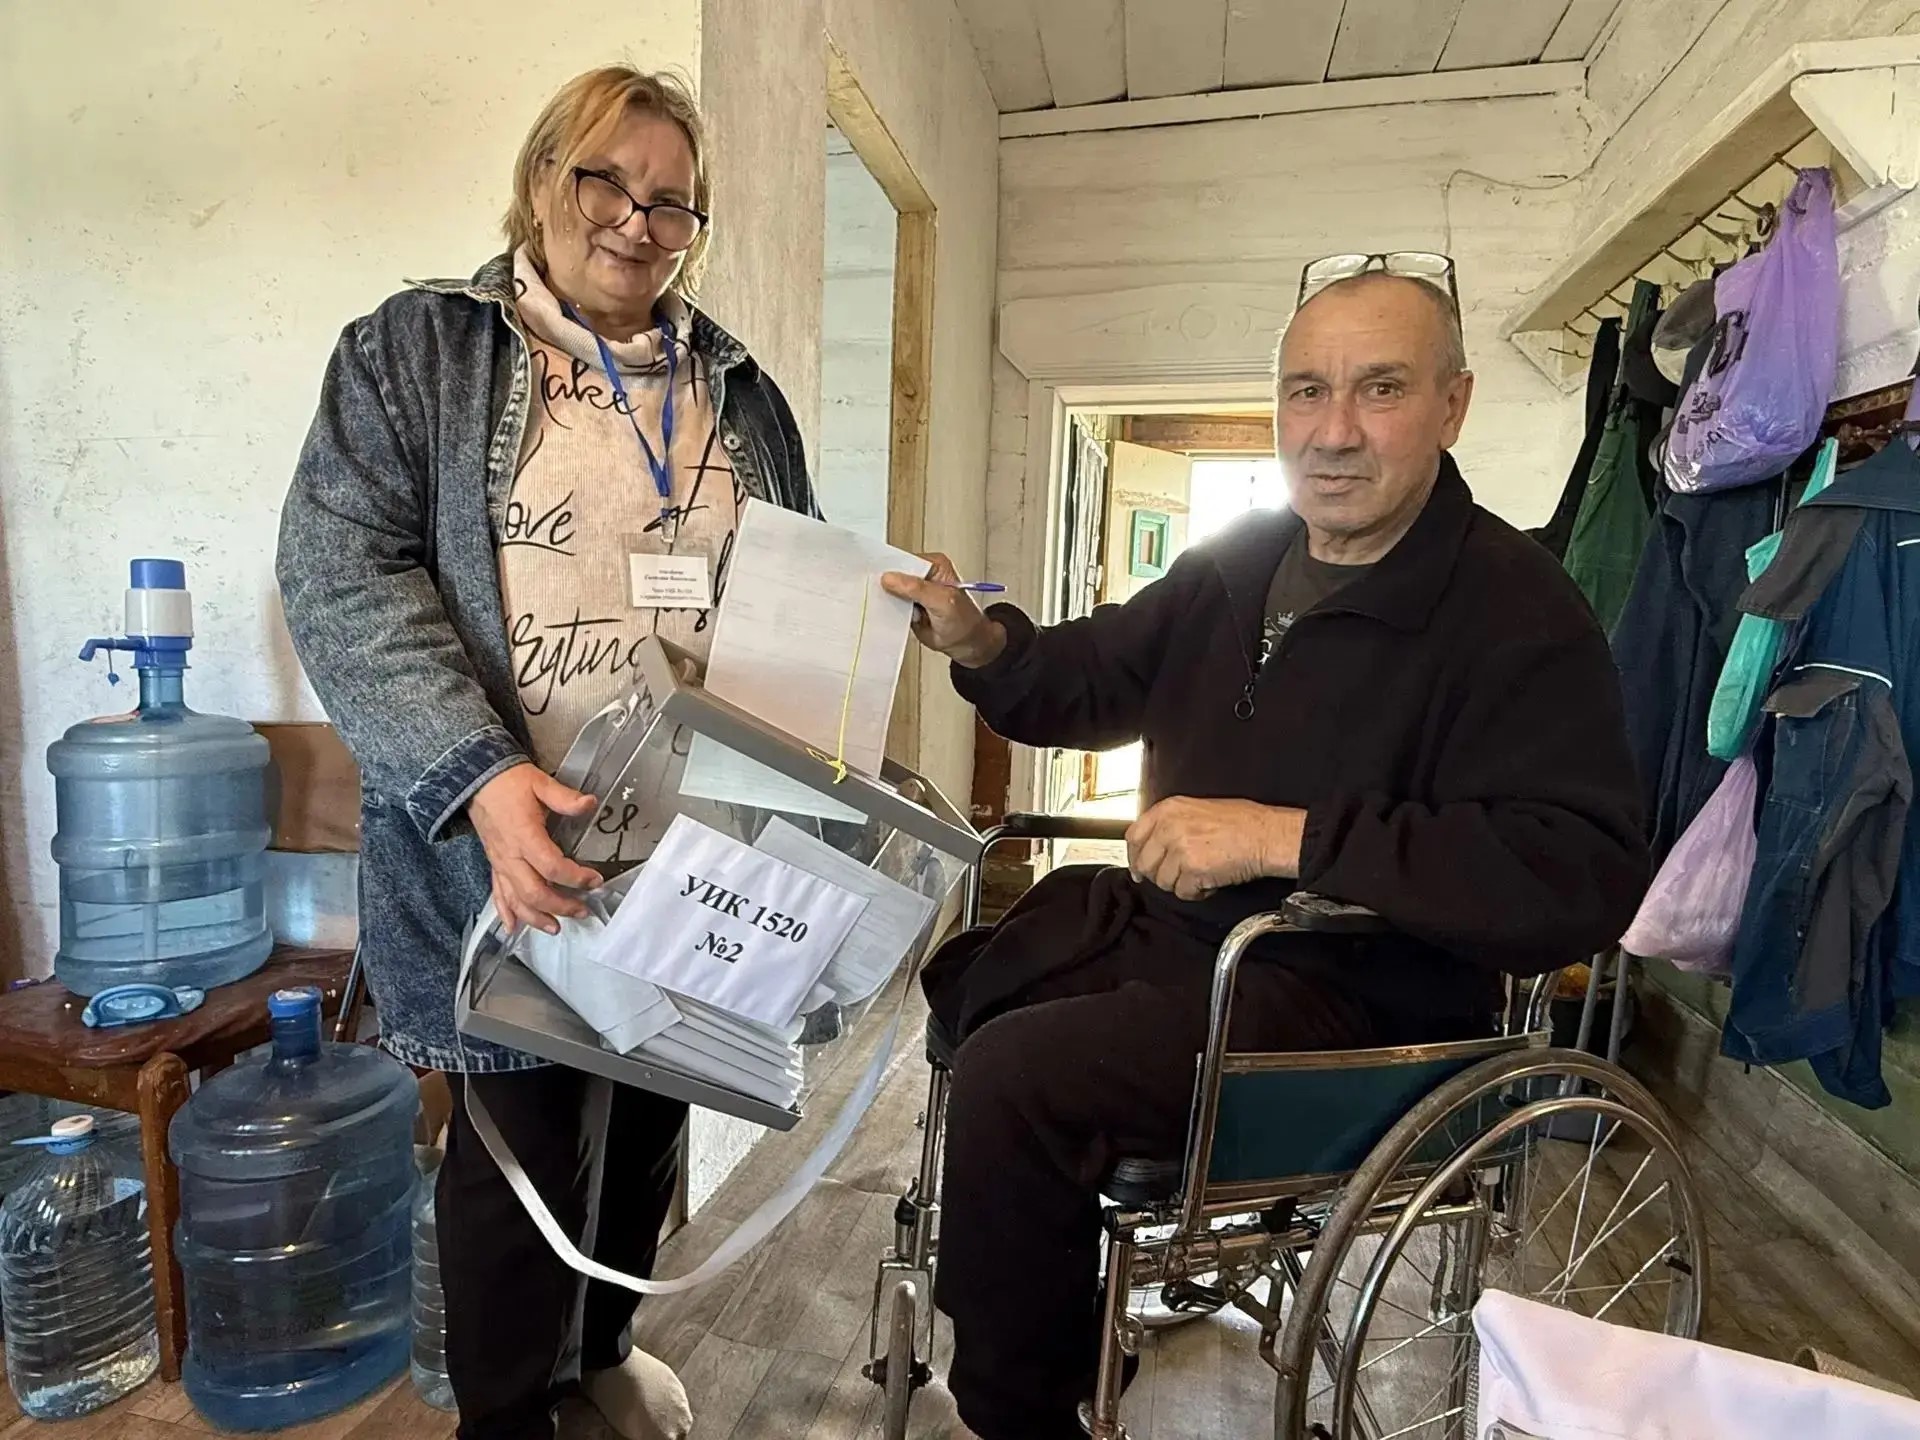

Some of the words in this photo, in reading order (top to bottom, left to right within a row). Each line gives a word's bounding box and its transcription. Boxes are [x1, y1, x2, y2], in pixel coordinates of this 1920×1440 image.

[679, 873, 750, 919] УИК
[747, 905, 808, 943] 1520
[694, 930, 744, 964] №2
